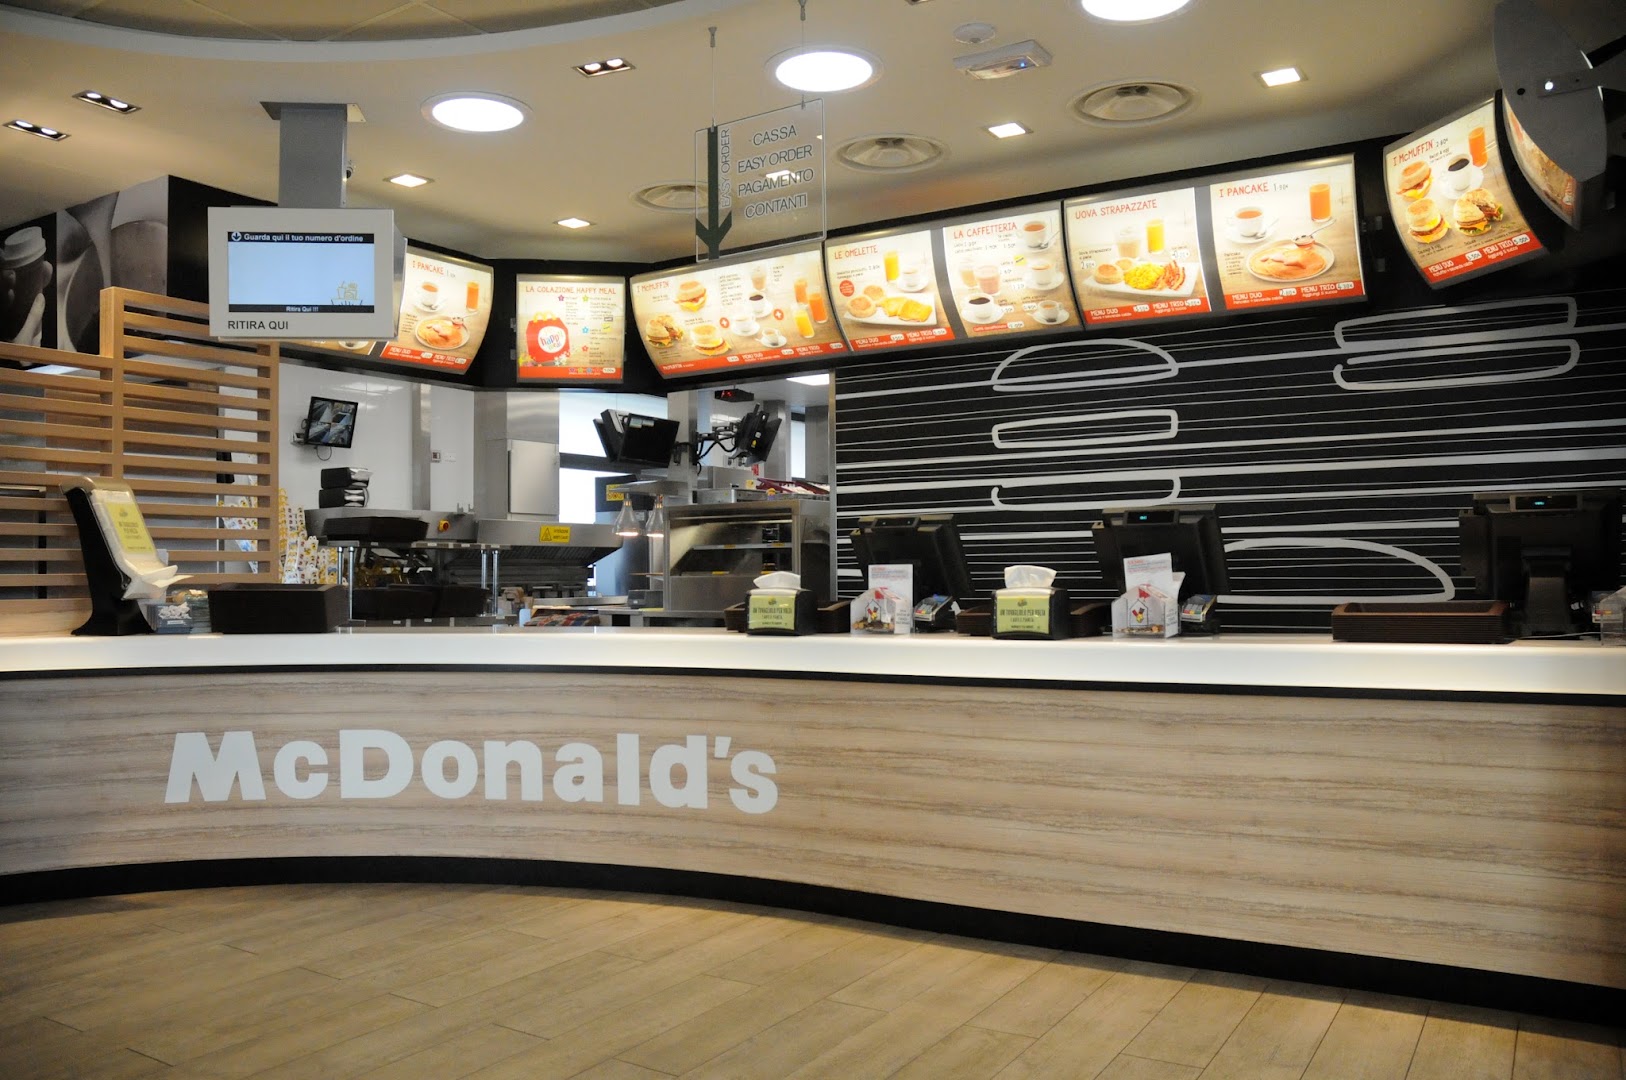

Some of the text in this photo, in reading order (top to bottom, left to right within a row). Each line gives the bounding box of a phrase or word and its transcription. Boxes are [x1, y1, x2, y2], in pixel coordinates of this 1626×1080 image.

[753, 125, 797, 146] CASSA
[738, 144, 813, 173] EASY ORDER
[1398, 140, 1433, 163] McMUFFIN
[721, 128, 731, 208] EASY ORDER
[738, 168, 814, 196] PAGAMENTO
[1219, 189, 1224, 197] I
[1227, 182, 1269, 196] PANCAKE
[745, 194, 808, 218] CONTANTI
[1075, 199, 1157, 219] UOVA STRAPAZZATE
[272, 234, 284, 242] qui
[953, 231, 963, 239] LA
[966, 222, 1017, 237] CAFFETTERIA
[834, 245, 878, 259] LE OMELETTE
[417, 261, 444, 275] PANCAKE
[537, 286, 574, 294] COLAZIONE
[641, 281, 669, 291] McMUFFIN
[228, 320, 289, 331] RITIRA QUI
[164, 729, 779, 814] McDonald's
